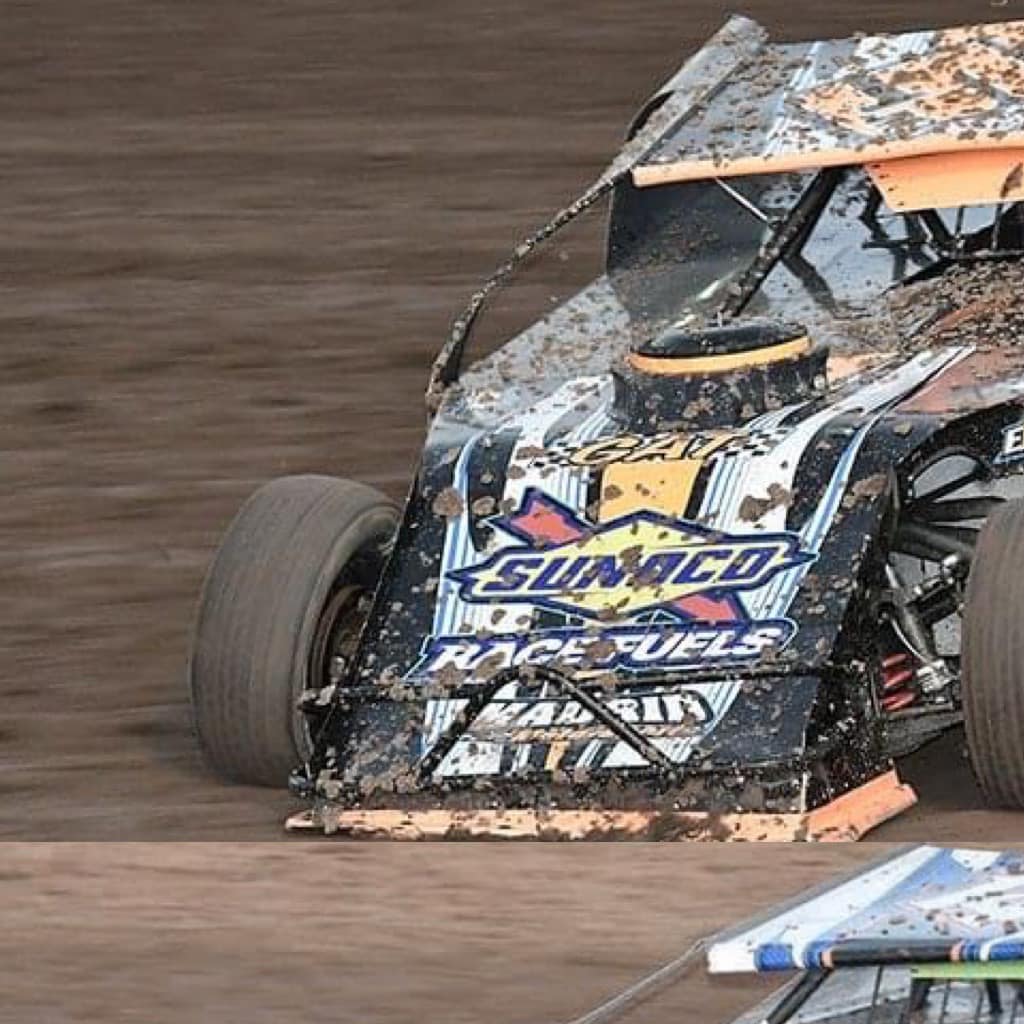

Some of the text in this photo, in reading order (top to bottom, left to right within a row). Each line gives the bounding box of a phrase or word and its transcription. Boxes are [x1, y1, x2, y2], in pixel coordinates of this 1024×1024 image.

[482, 547, 781, 591] SUNOCO
[432, 627, 781, 671] RACE FUELS
